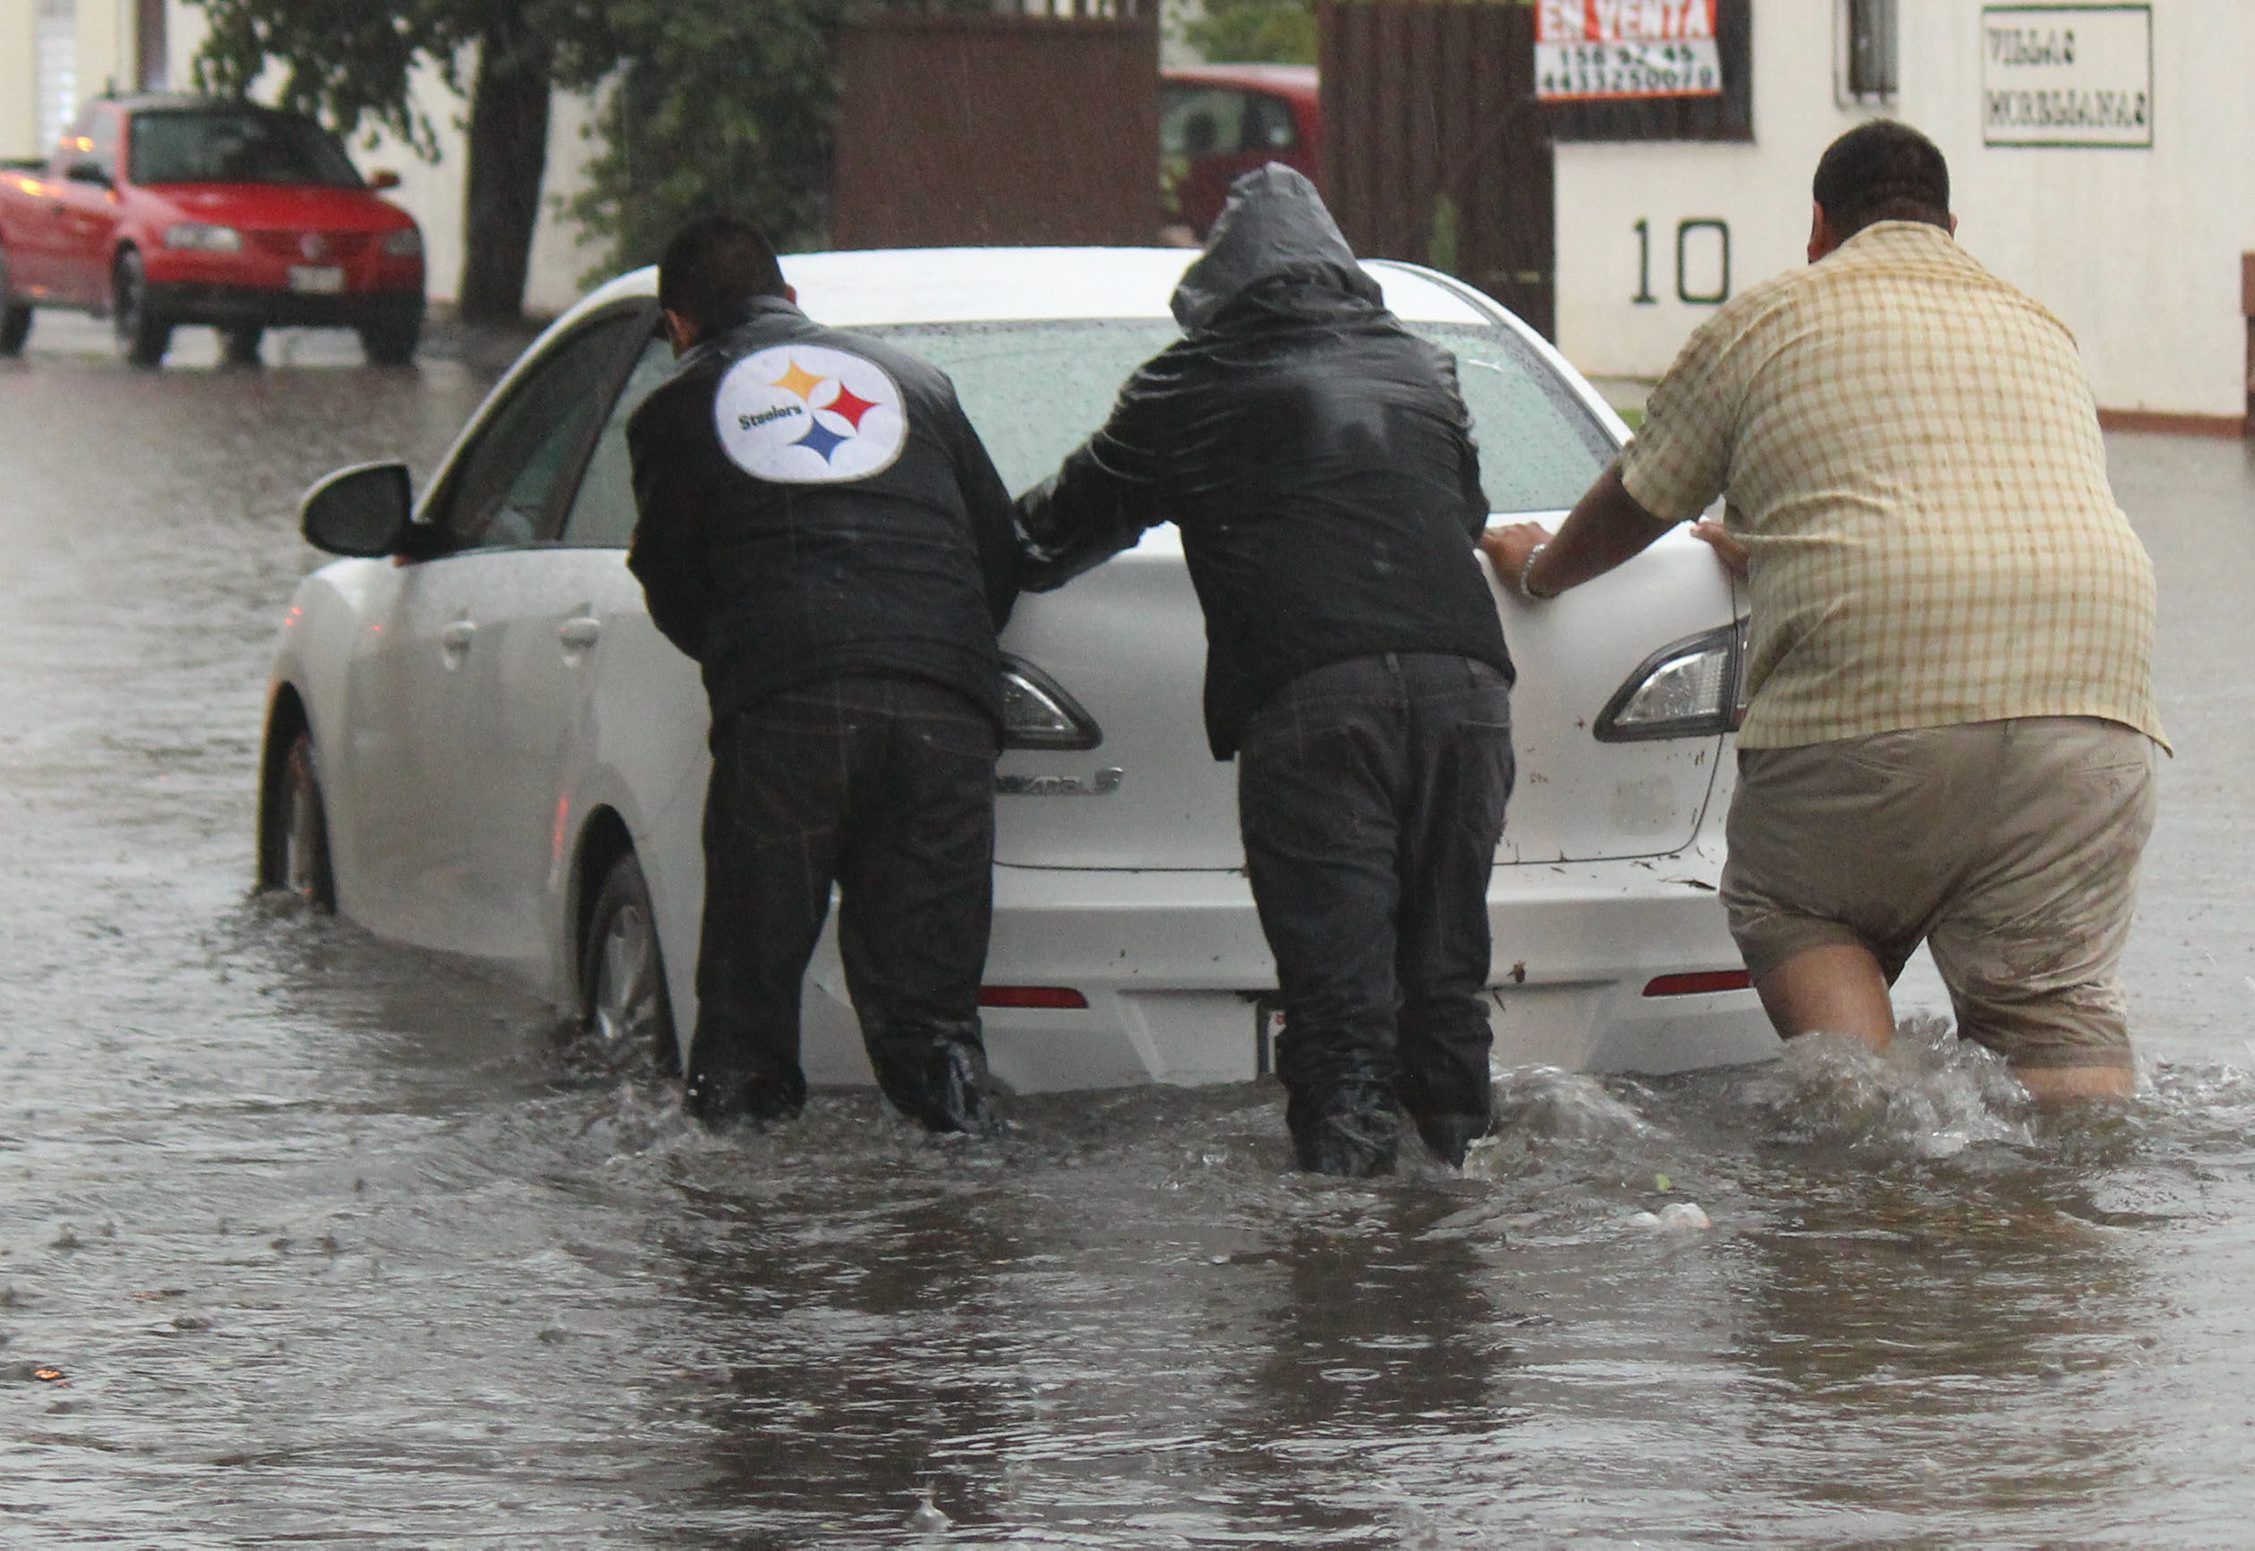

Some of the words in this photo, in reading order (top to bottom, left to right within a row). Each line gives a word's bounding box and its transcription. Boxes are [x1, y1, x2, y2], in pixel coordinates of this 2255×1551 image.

[1540, 0, 1585, 41] EN
[1595, 0, 1713, 40] VENTA
[1987, 28, 2076, 66] VILLAS
[1632, 216, 1730, 304] 10
[738, 405, 802, 431] Steelers
